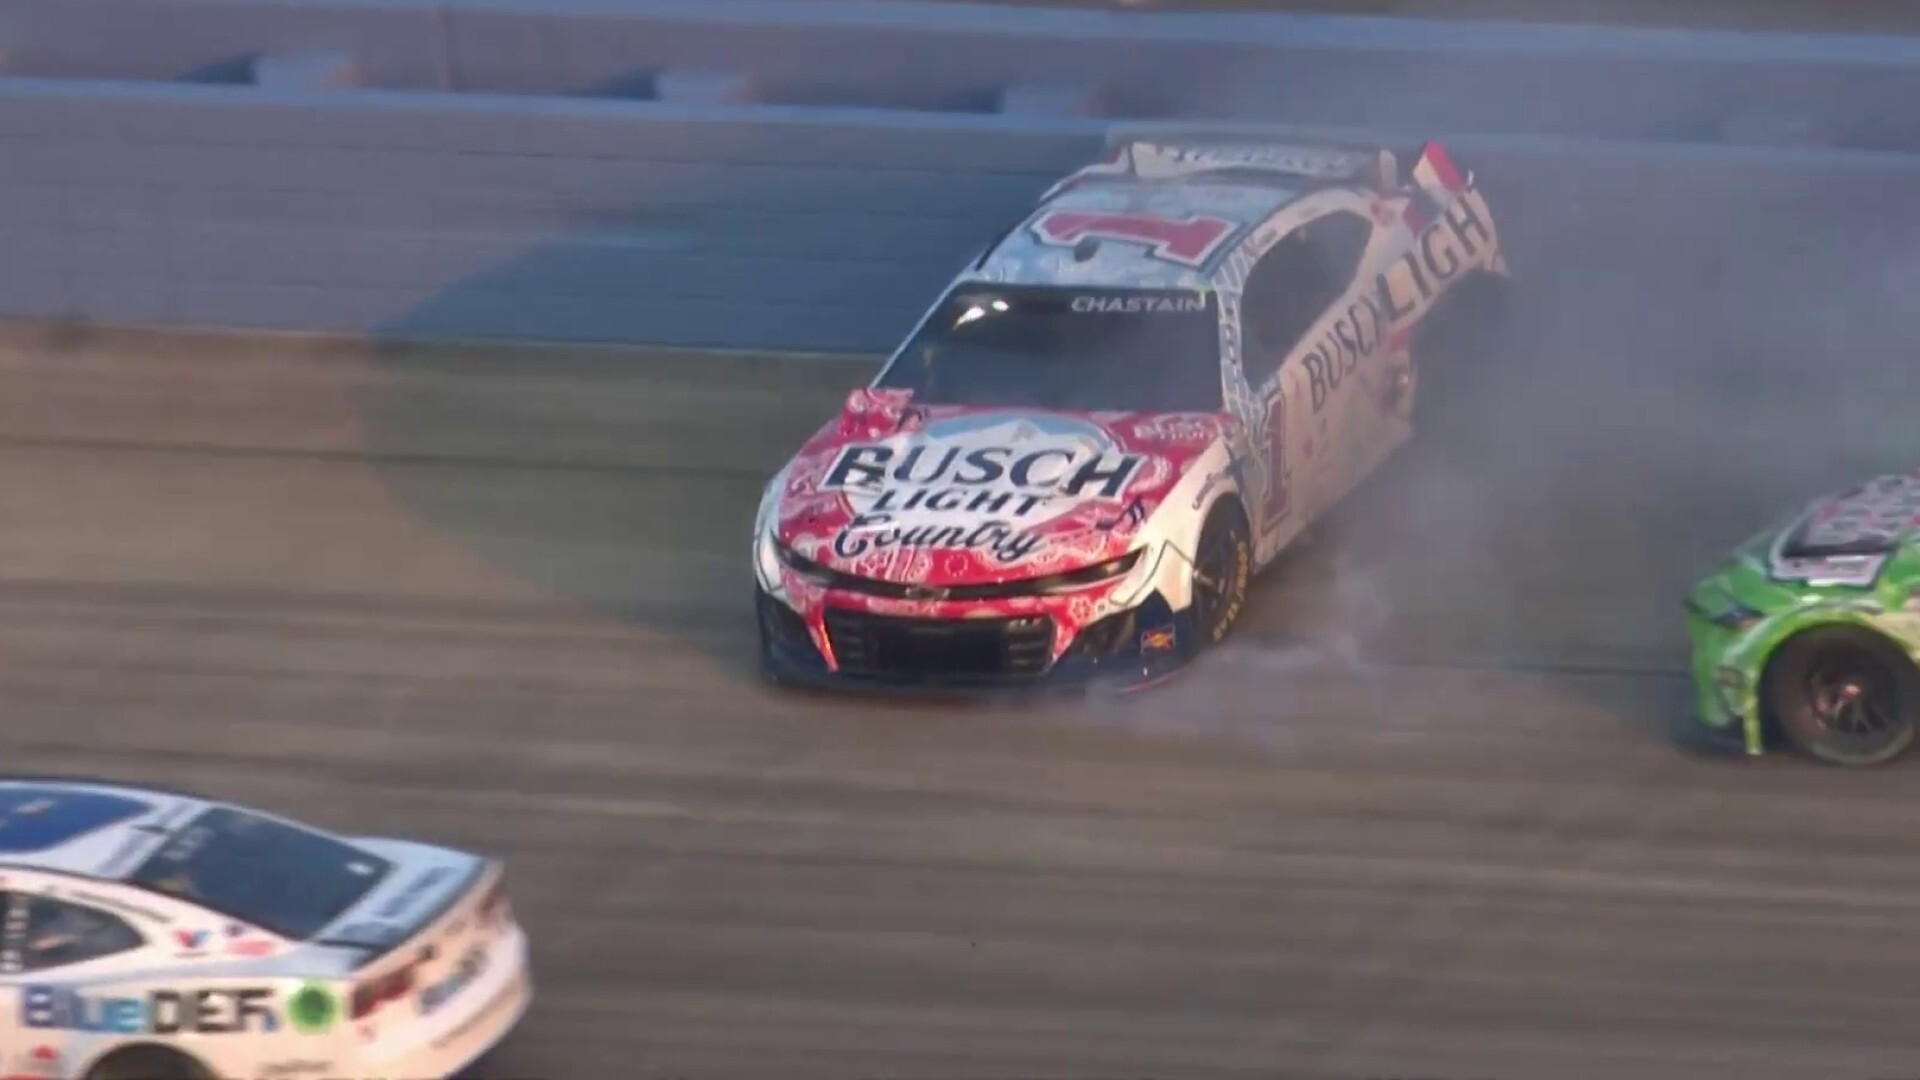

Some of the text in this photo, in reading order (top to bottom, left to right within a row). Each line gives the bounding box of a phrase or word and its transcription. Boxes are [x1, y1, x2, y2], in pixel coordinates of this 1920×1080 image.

[1034, 209, 1236, 268] 1
[1071, 295, 1206, 313] CHASTAIN
[824, 445, 1142, 498] BUSCH
[869, 488, 1054, 517] LIGHT
[834, 513, 1054, 563] Country
